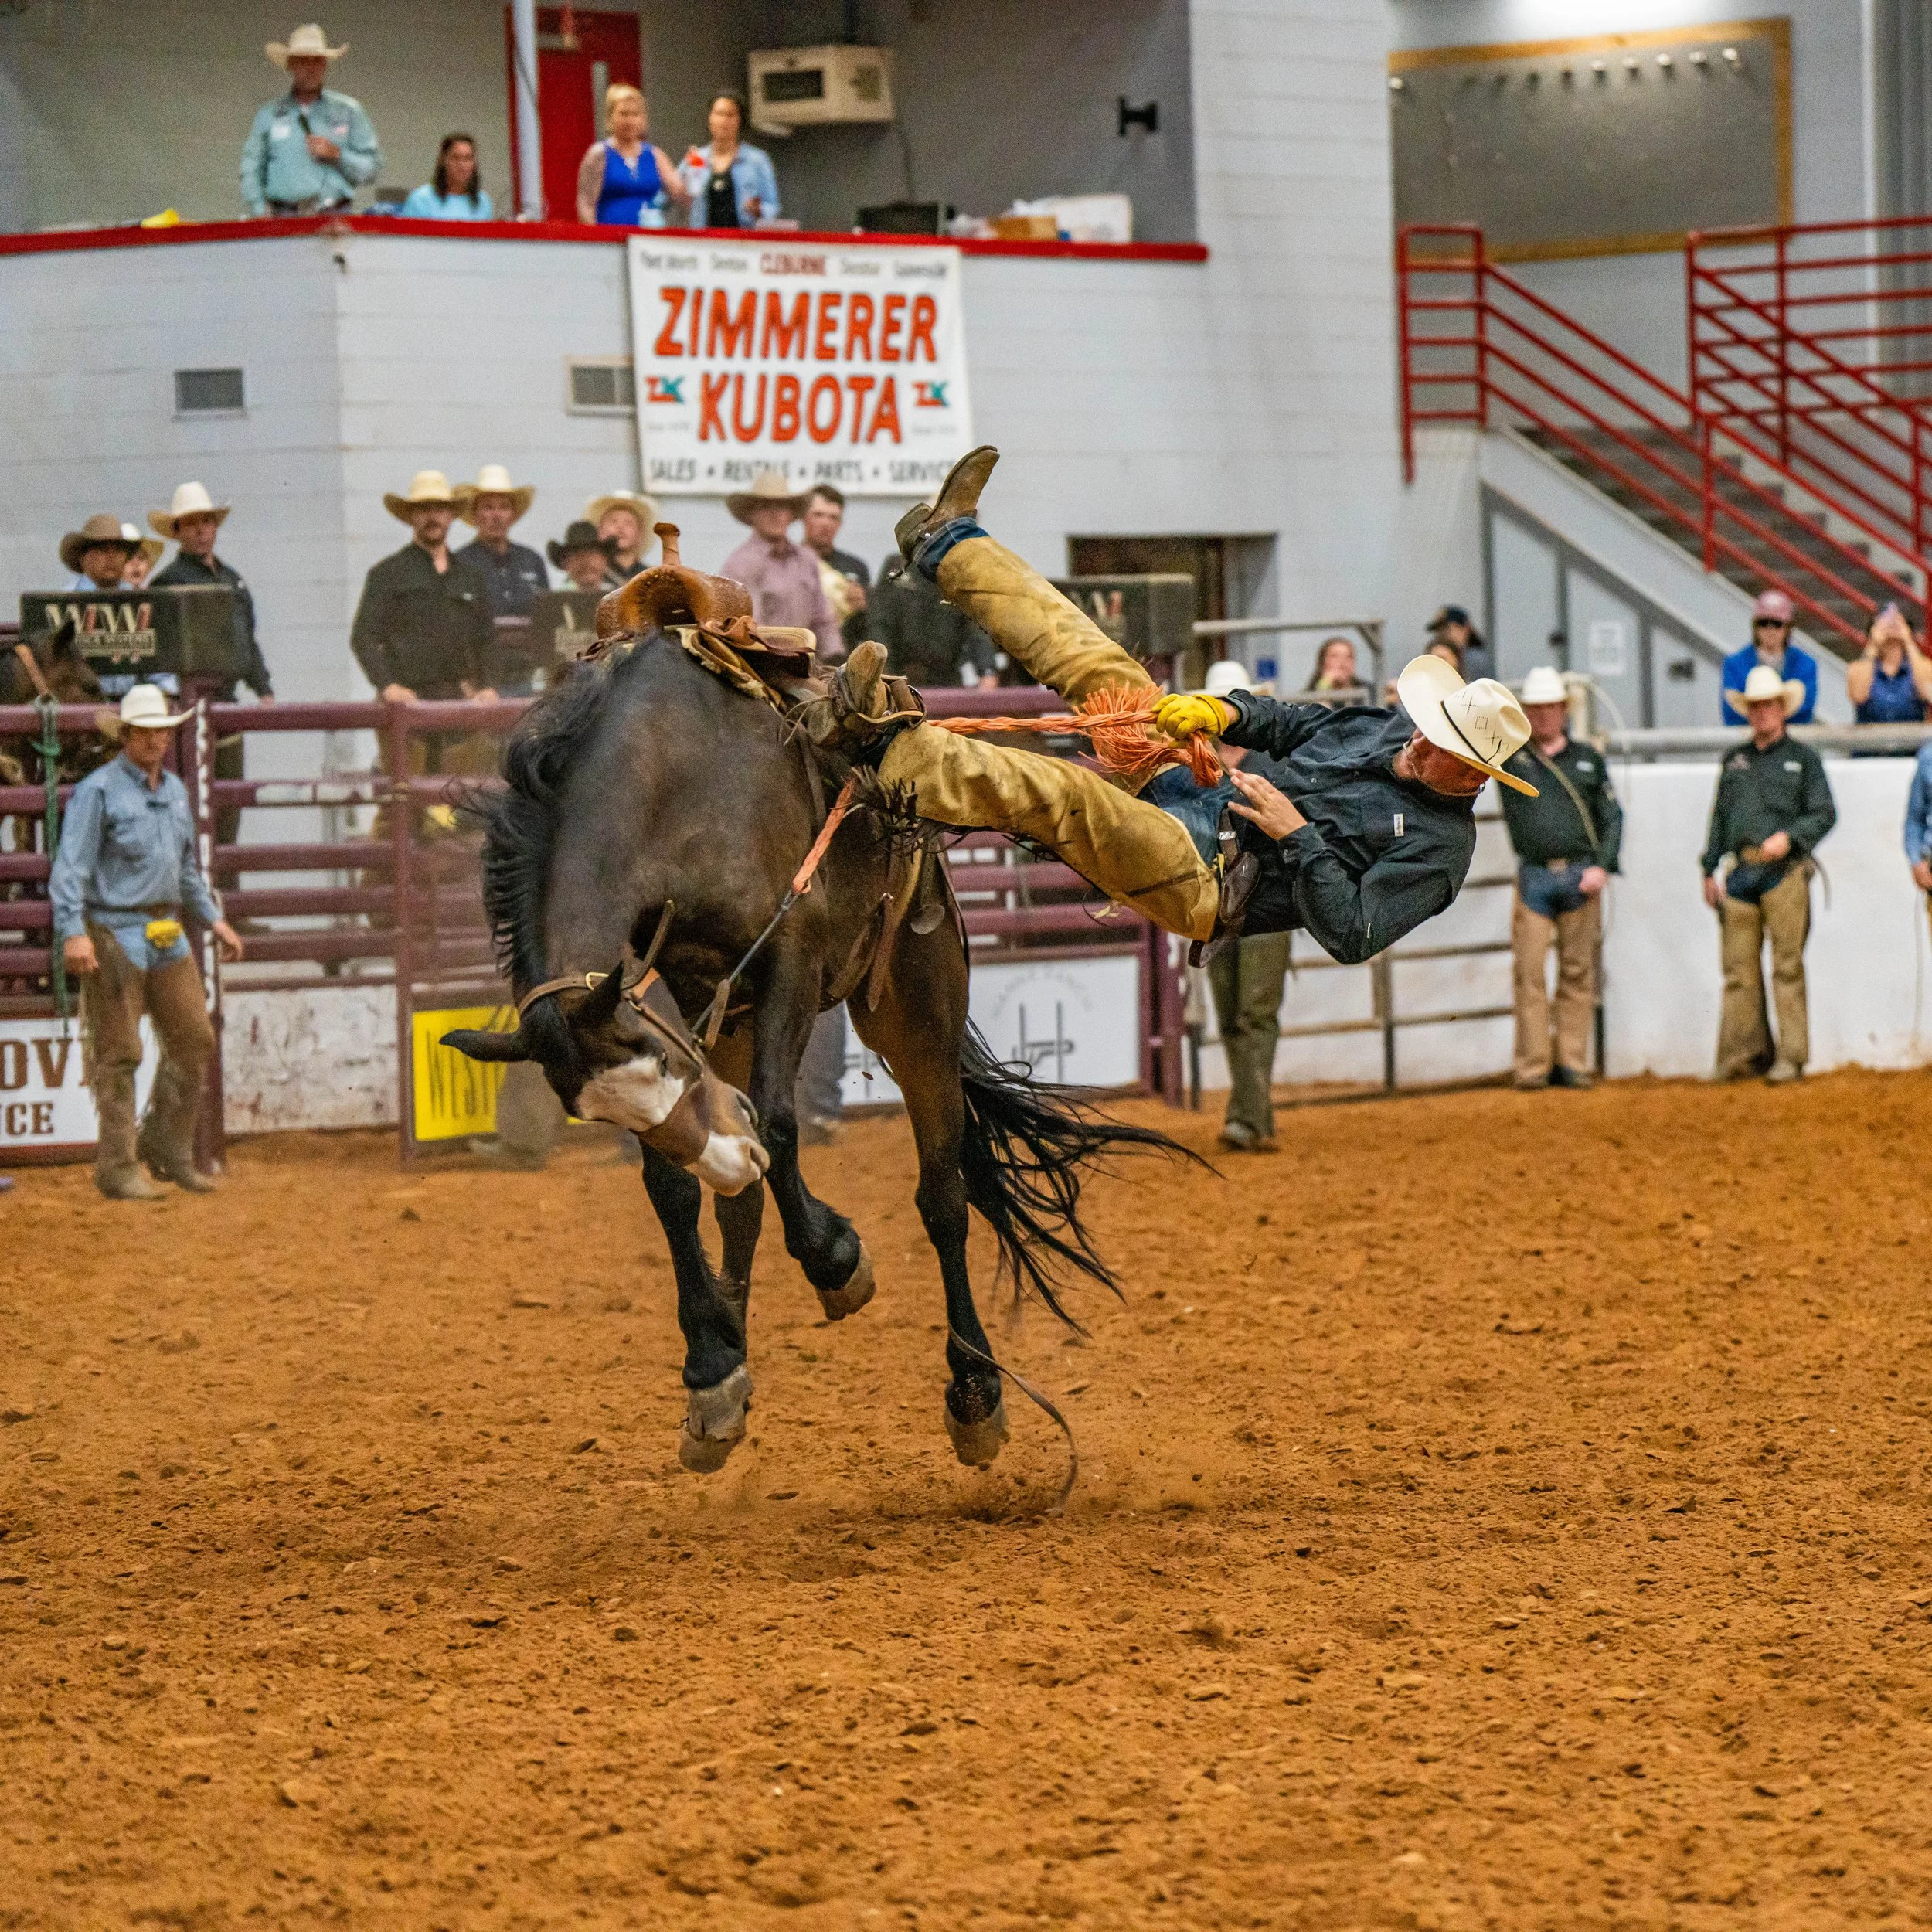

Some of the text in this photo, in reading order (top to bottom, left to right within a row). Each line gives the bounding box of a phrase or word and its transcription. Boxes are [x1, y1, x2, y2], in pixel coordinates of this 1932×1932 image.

[655, 287, 937, 362] ZIMMERER
[698, 372, 901, 444] KUBOTA
[651, 458, 696, 482] SALES
[815, 460, 862, 482] PARTS
[889, 460, 955, 482] SERVIC
[0, 1038, 90, 1090] OV
[0, 1103, 54, 1136] CE
